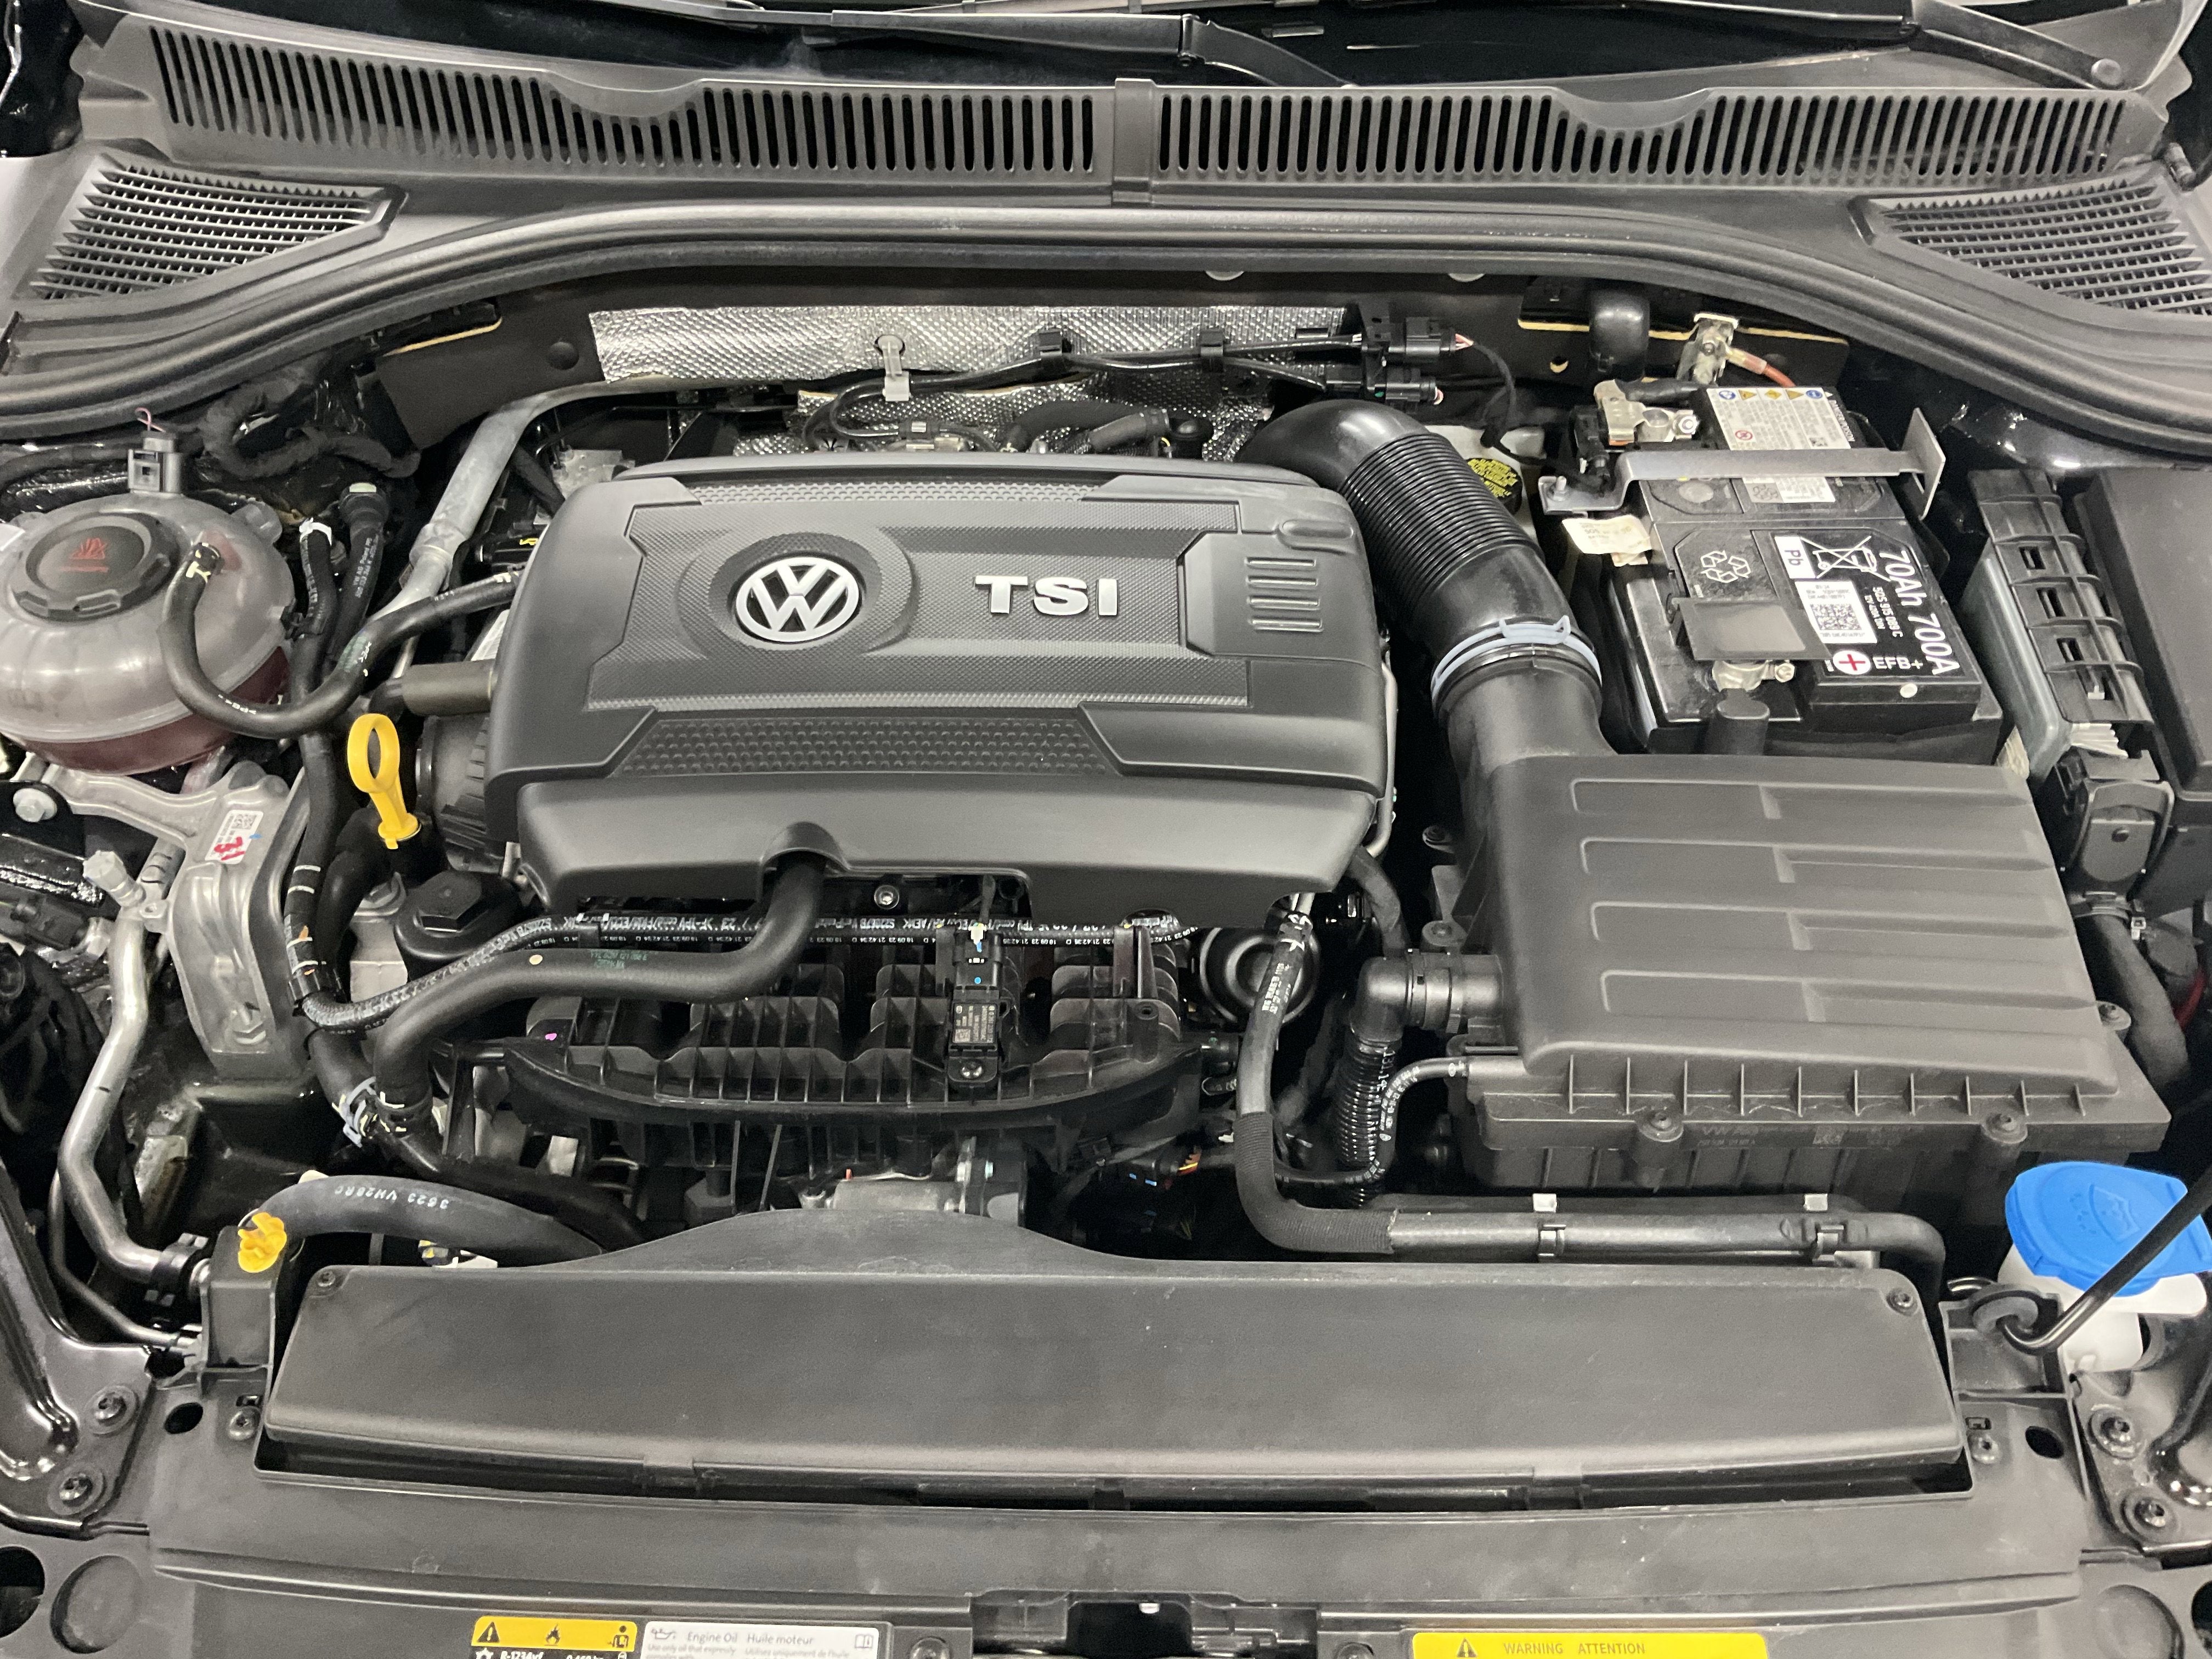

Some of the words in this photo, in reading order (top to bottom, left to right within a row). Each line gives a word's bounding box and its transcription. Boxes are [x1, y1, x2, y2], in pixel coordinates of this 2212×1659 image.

[1784, 550, 1803, 566] Pb
[736, 557, 859, 642] VW
[975, 574, 1118, 617] TSI
[1879, 550, 1927, 606] 70Ah
[1908, 613, 1960, 675] 700A
[1872, 657, 1923, 669] EFB+
[687, 1632, 721, 1645] Engine
[723, 1633, 738, 1643] Oil
[747, 1634, 773, 1644] Huile
[776, 1635, 814, 1645] moteur
[1503, 1643, 1563, 1654] WARNING
[1578, 1643, 1645, 1654] ATTENTION
